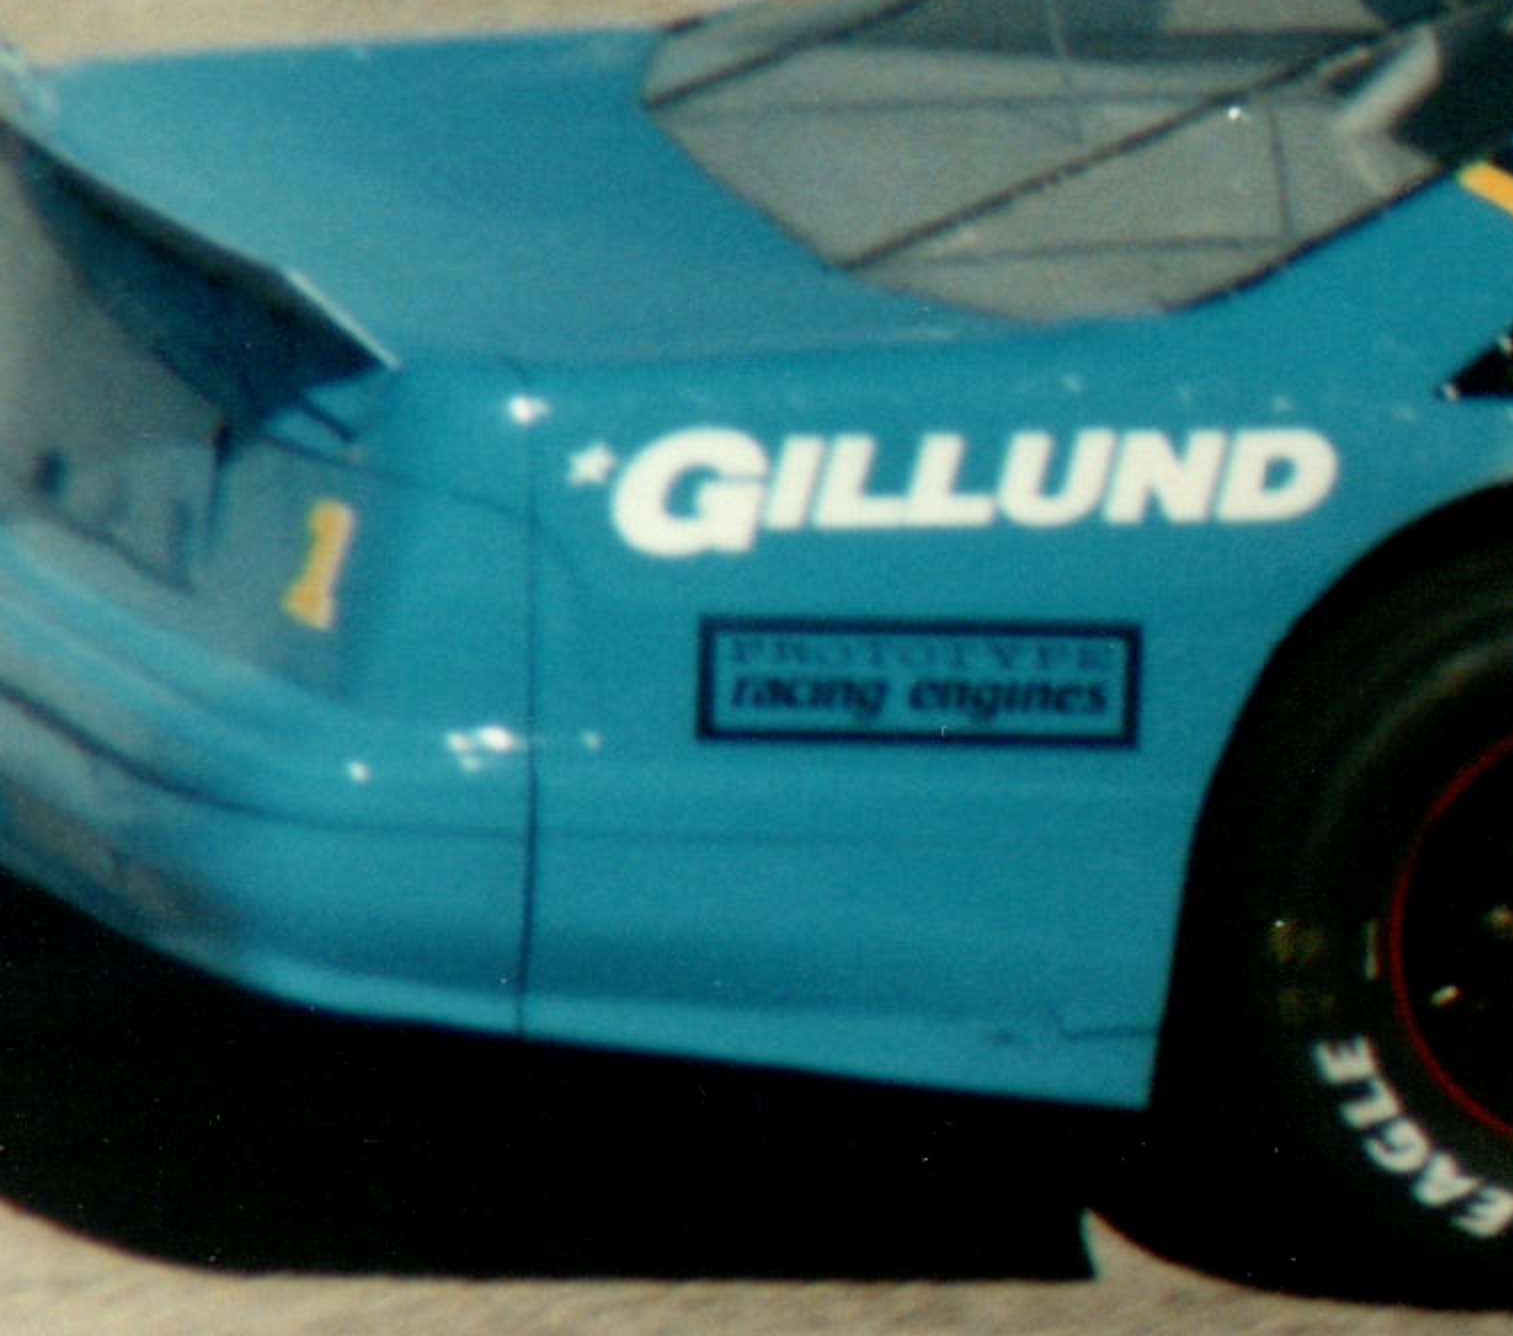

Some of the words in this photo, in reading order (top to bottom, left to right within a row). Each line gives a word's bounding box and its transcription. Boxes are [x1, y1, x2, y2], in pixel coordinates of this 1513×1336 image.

[611, 426, 1340, 557] GILLUND
[730, 674, 890, 721] racing
[907, 678, 1110, 726] engines
